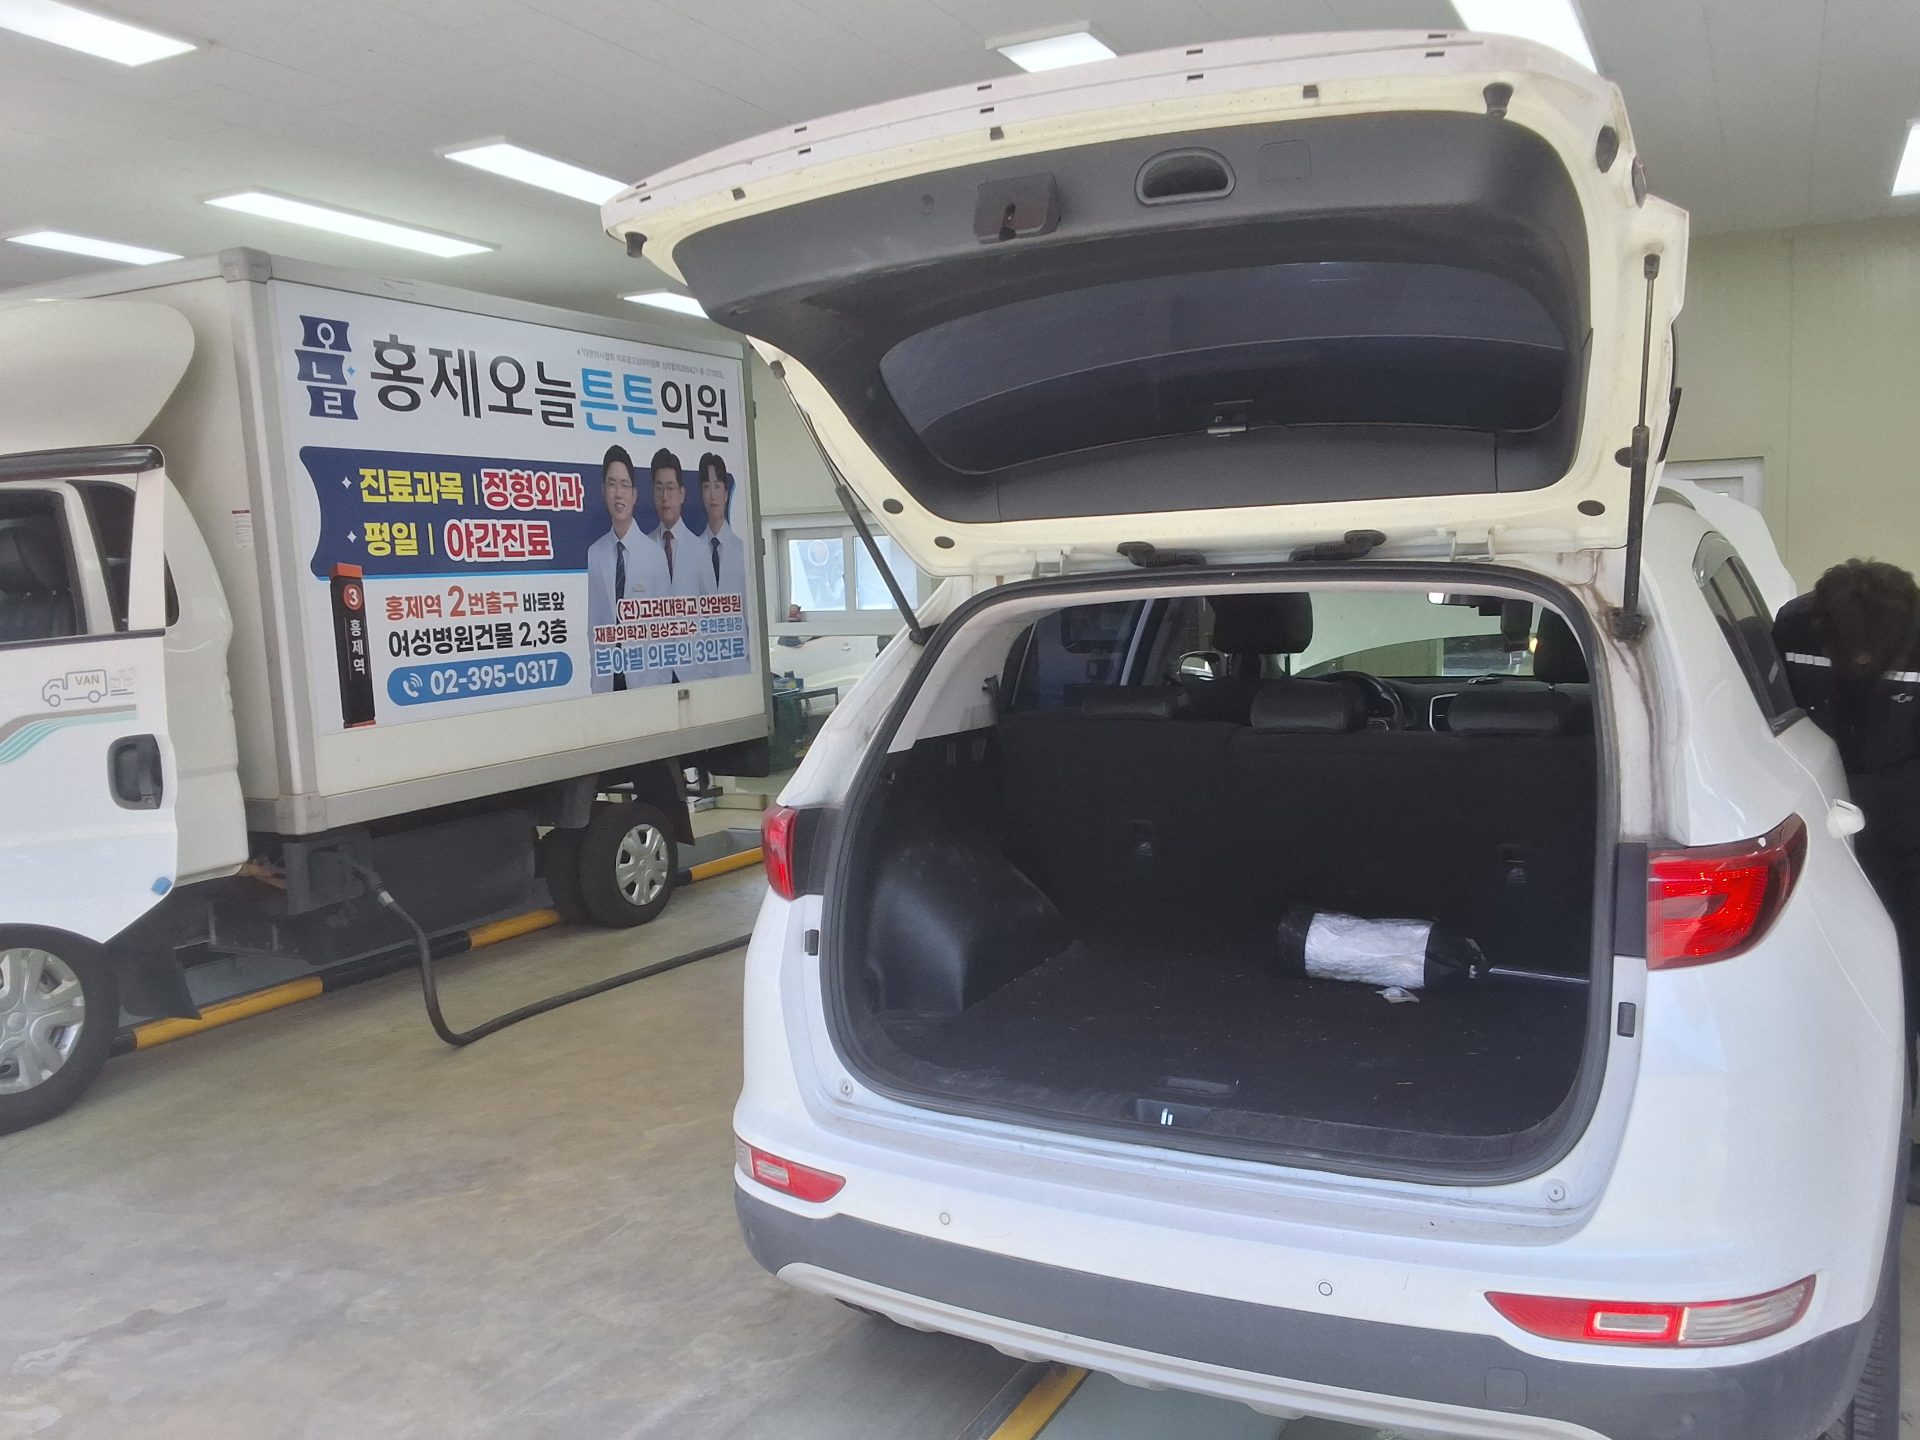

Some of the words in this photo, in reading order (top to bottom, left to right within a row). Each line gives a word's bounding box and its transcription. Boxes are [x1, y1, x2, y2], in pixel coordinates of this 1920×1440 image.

[370, 334, 729, 443] 홍제오늘튼튼의원
[358, 468, 464, 506] 진료과목
[482, 470, 583, 510] 정형외과
[363, 522, 419, 557] 평일
[445, 521, 552, 560] 야간진료
[385, 594, 443, 621] 홍제역
[523, 591, 565, 613] 바로앞
[617, 597, 698, 621] (전)고려대학교
[700, 594, 742, 615] 안암병원
[350, 618, 366, 676] 홍제역
[388, 622, 514, 658] 여성병원건물
[519, 618, 568, 648] 2,3층
[595, 623, 648, 643] 재활의학과
[650, 620, 698, 638] 임상조교수
[595, 646, 644, 676] 분야별
[649, 642, 692, 668] 의료인
[696, 637, 745, 663] 3인진료
[74, 674, 101, 686] VAN
[430, 658, 558, 696] 02-395-0317
